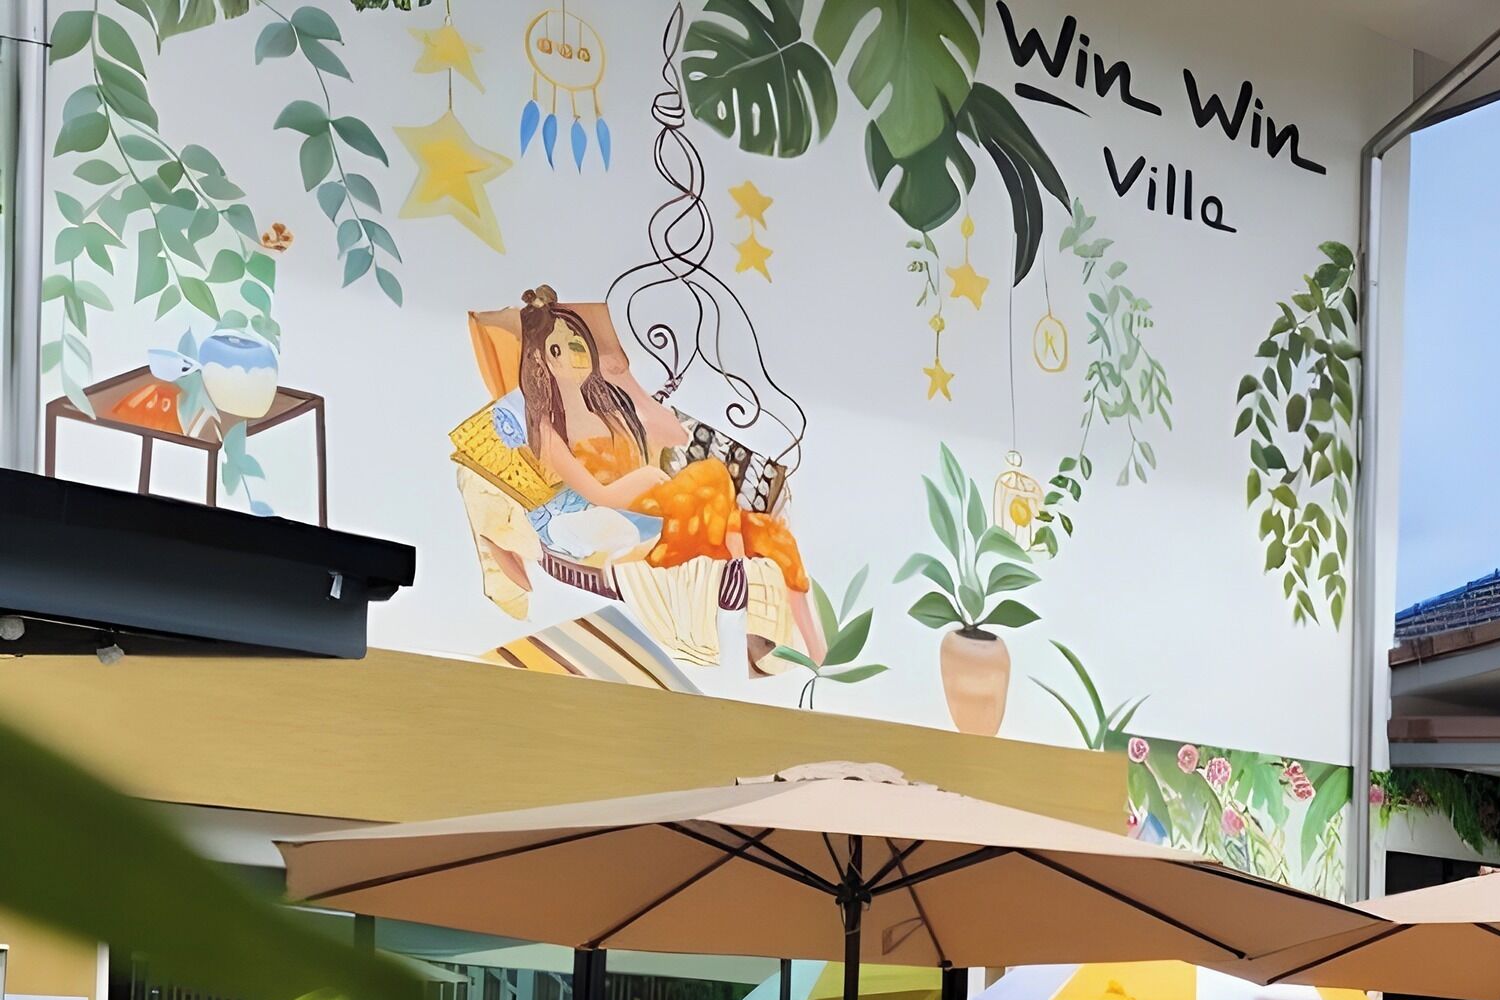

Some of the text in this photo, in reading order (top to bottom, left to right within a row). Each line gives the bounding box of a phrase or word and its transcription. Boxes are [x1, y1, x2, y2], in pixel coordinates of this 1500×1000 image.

[996, 0, 1327, 176] Win Win
[1103, 146, 1237, 233] Villa
